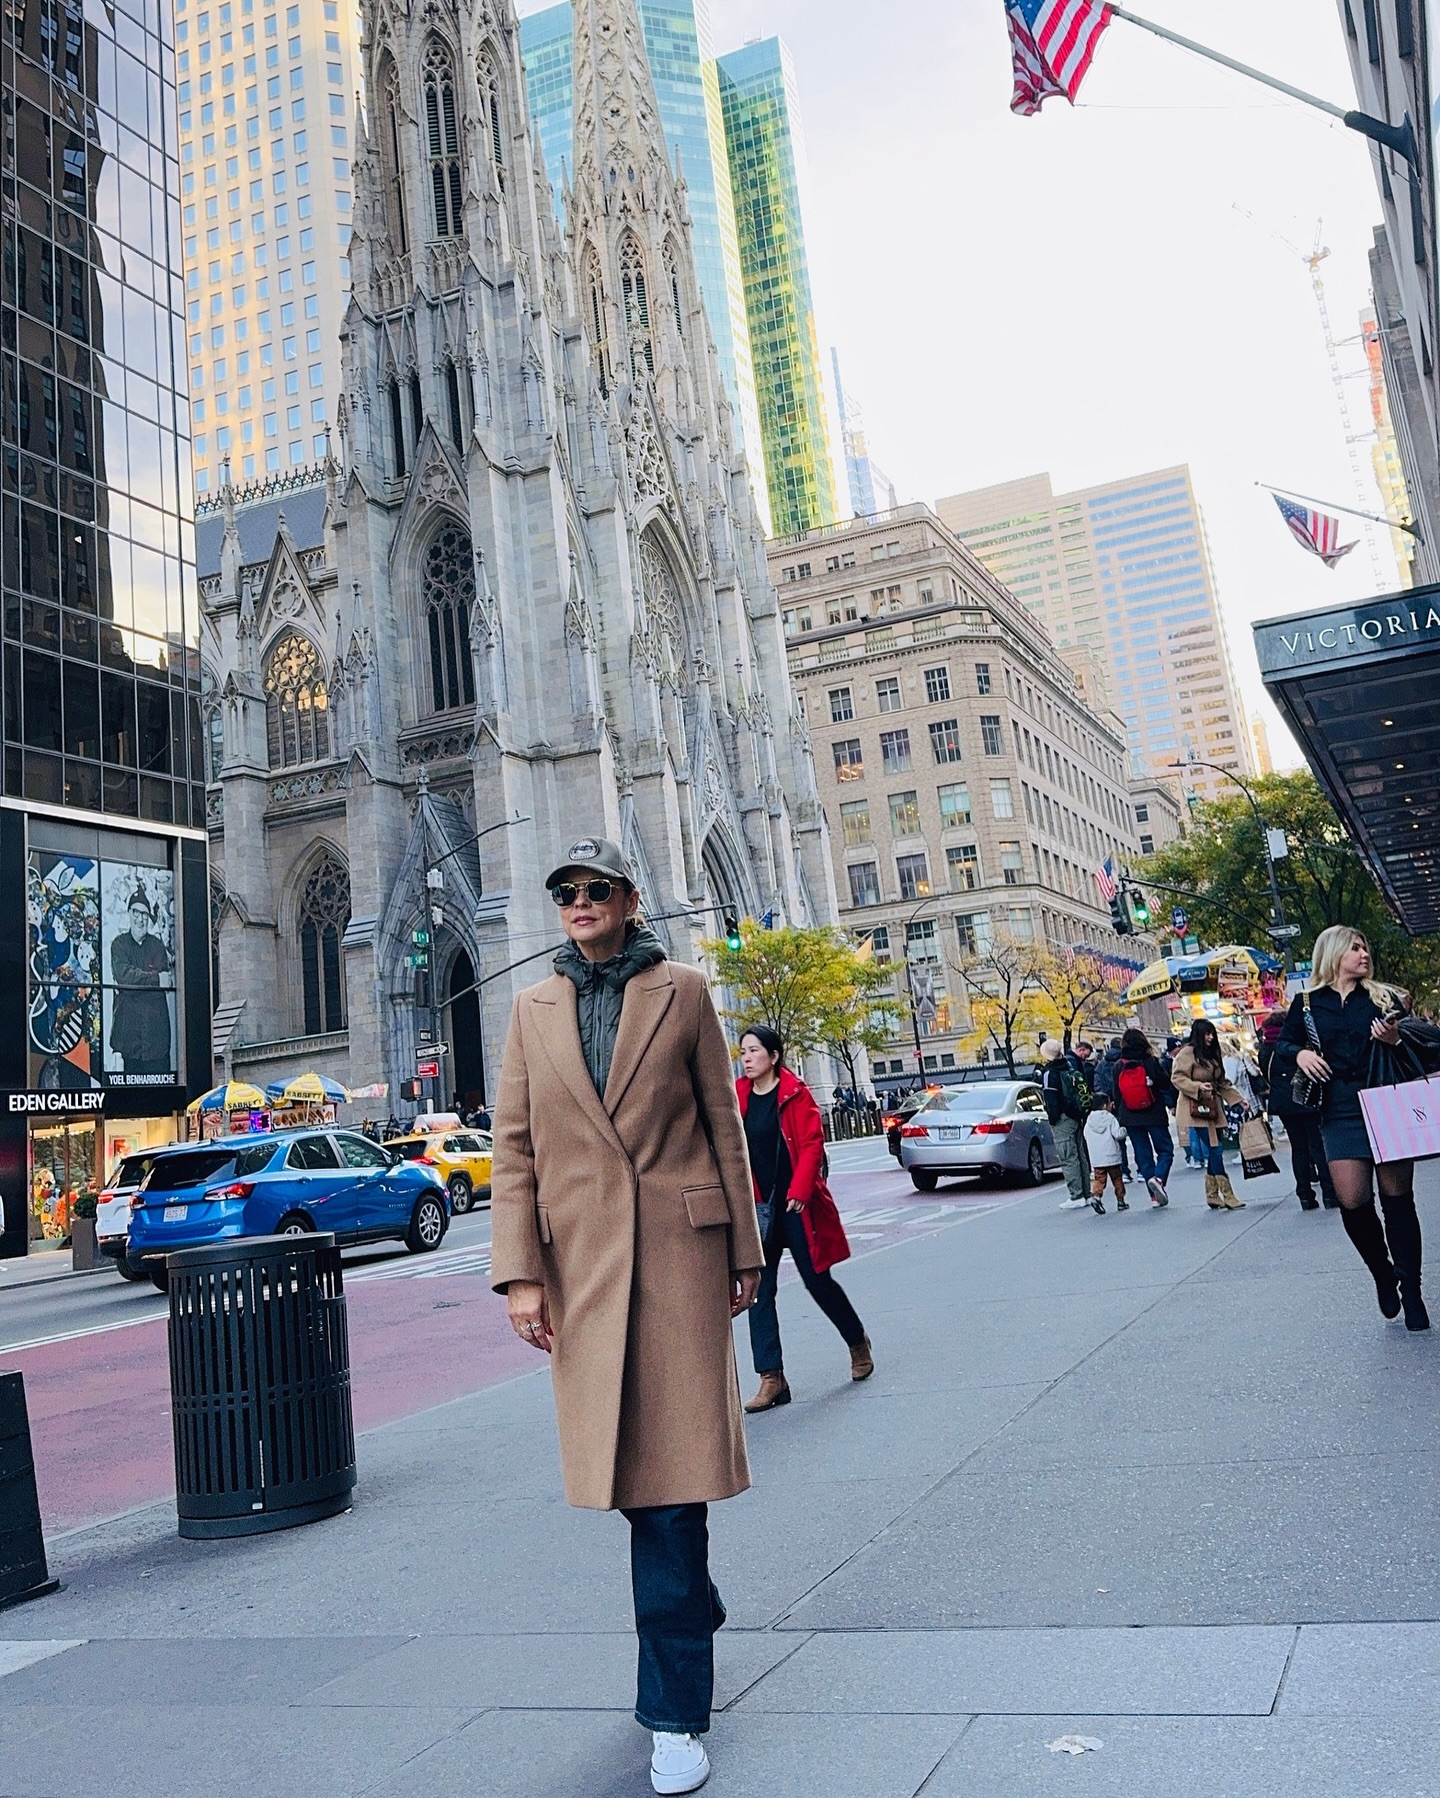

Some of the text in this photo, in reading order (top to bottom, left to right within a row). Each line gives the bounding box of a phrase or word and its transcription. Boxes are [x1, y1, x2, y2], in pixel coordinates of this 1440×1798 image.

[1280, 608, 1440, 656] VICTORIA
[1130, 980, 1170, 998] SABRETT
[109, 1074, 175, 1085] YOEL BENHARROUCHE
[9, 1092, 106, 1112] EDEN GALLERY
